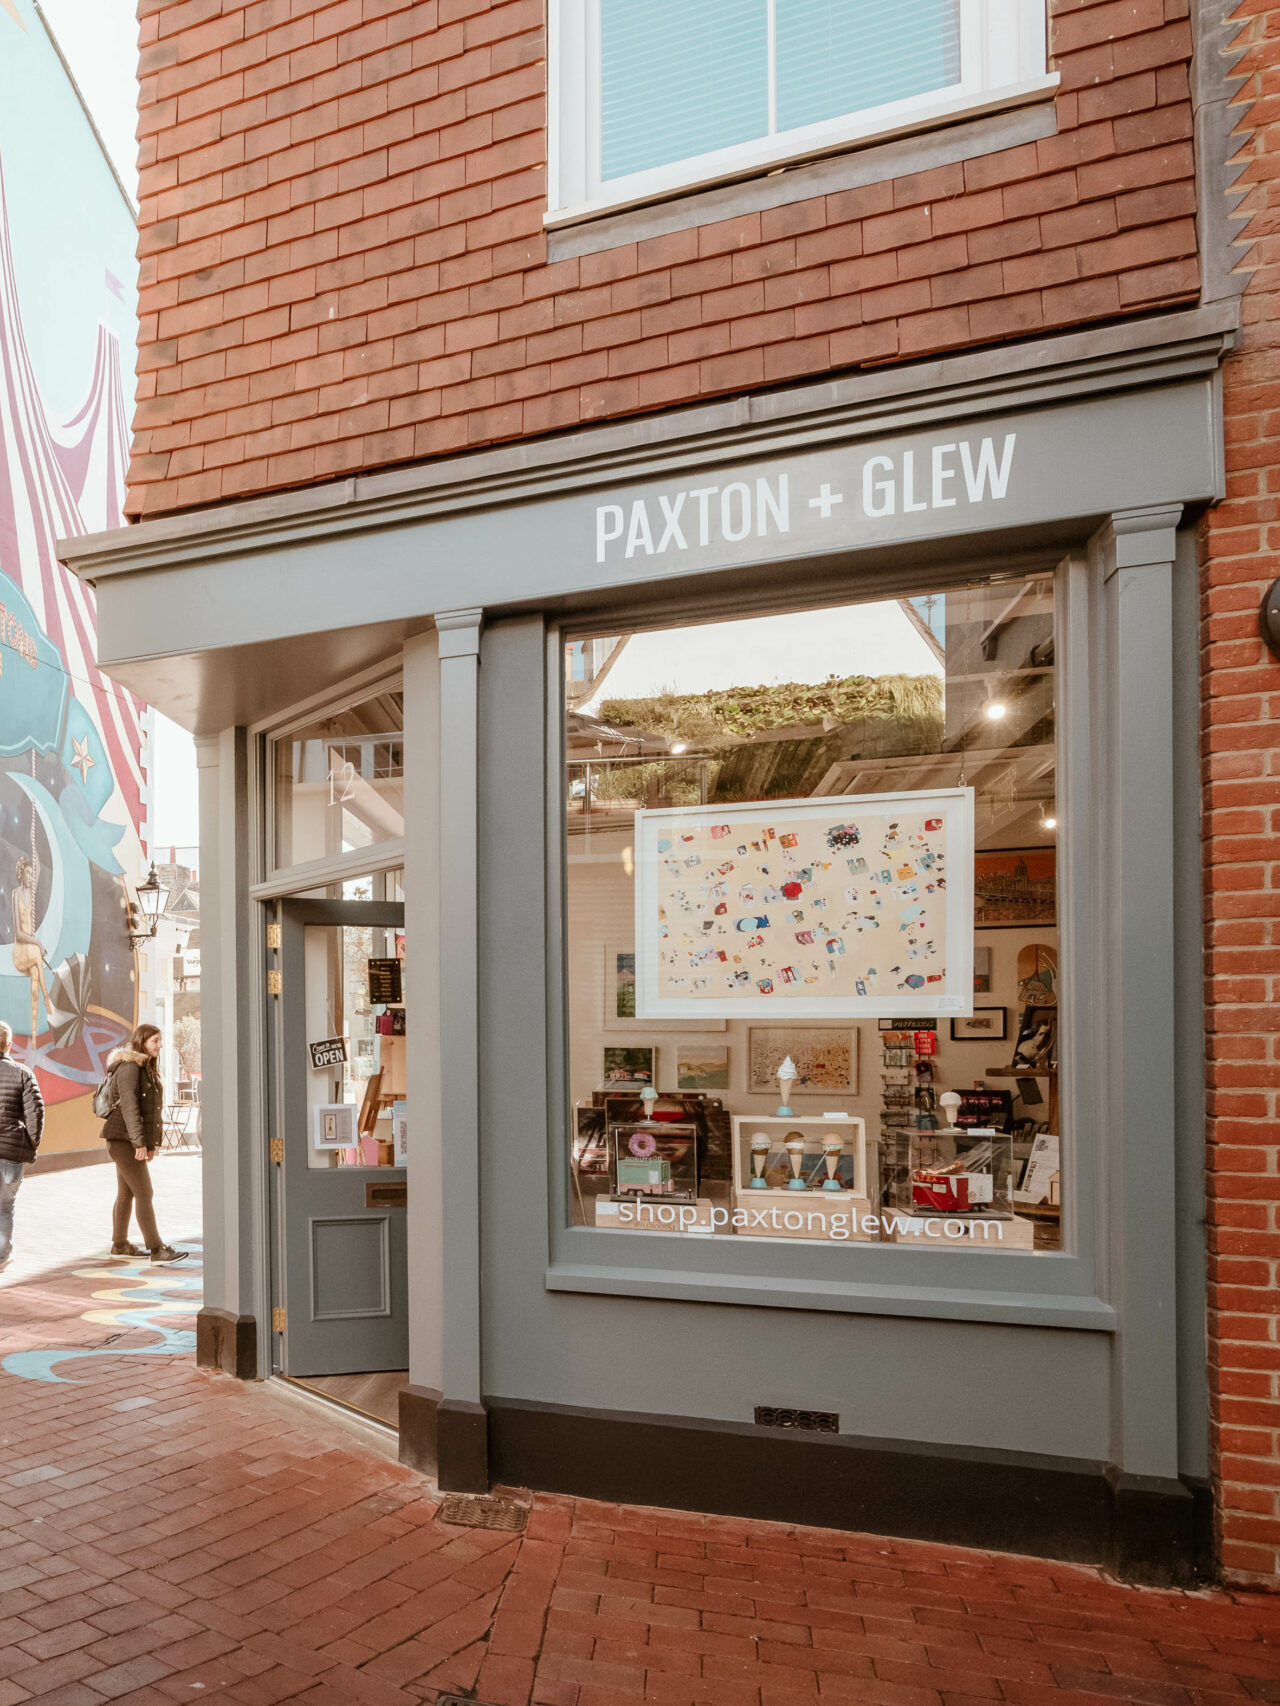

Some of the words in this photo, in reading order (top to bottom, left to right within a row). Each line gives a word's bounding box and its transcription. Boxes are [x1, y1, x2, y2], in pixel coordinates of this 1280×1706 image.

[596, 473, 790, 563] PAXTON
[809, 483, 843, 518] +
[862, 433, 1017, 518] GLEW
[326, 762, 355, 807] 12
[315, 1048, 344, 1066] OPEN
[619, 1197, 1003, 1241] shop.paxtonglew.com
